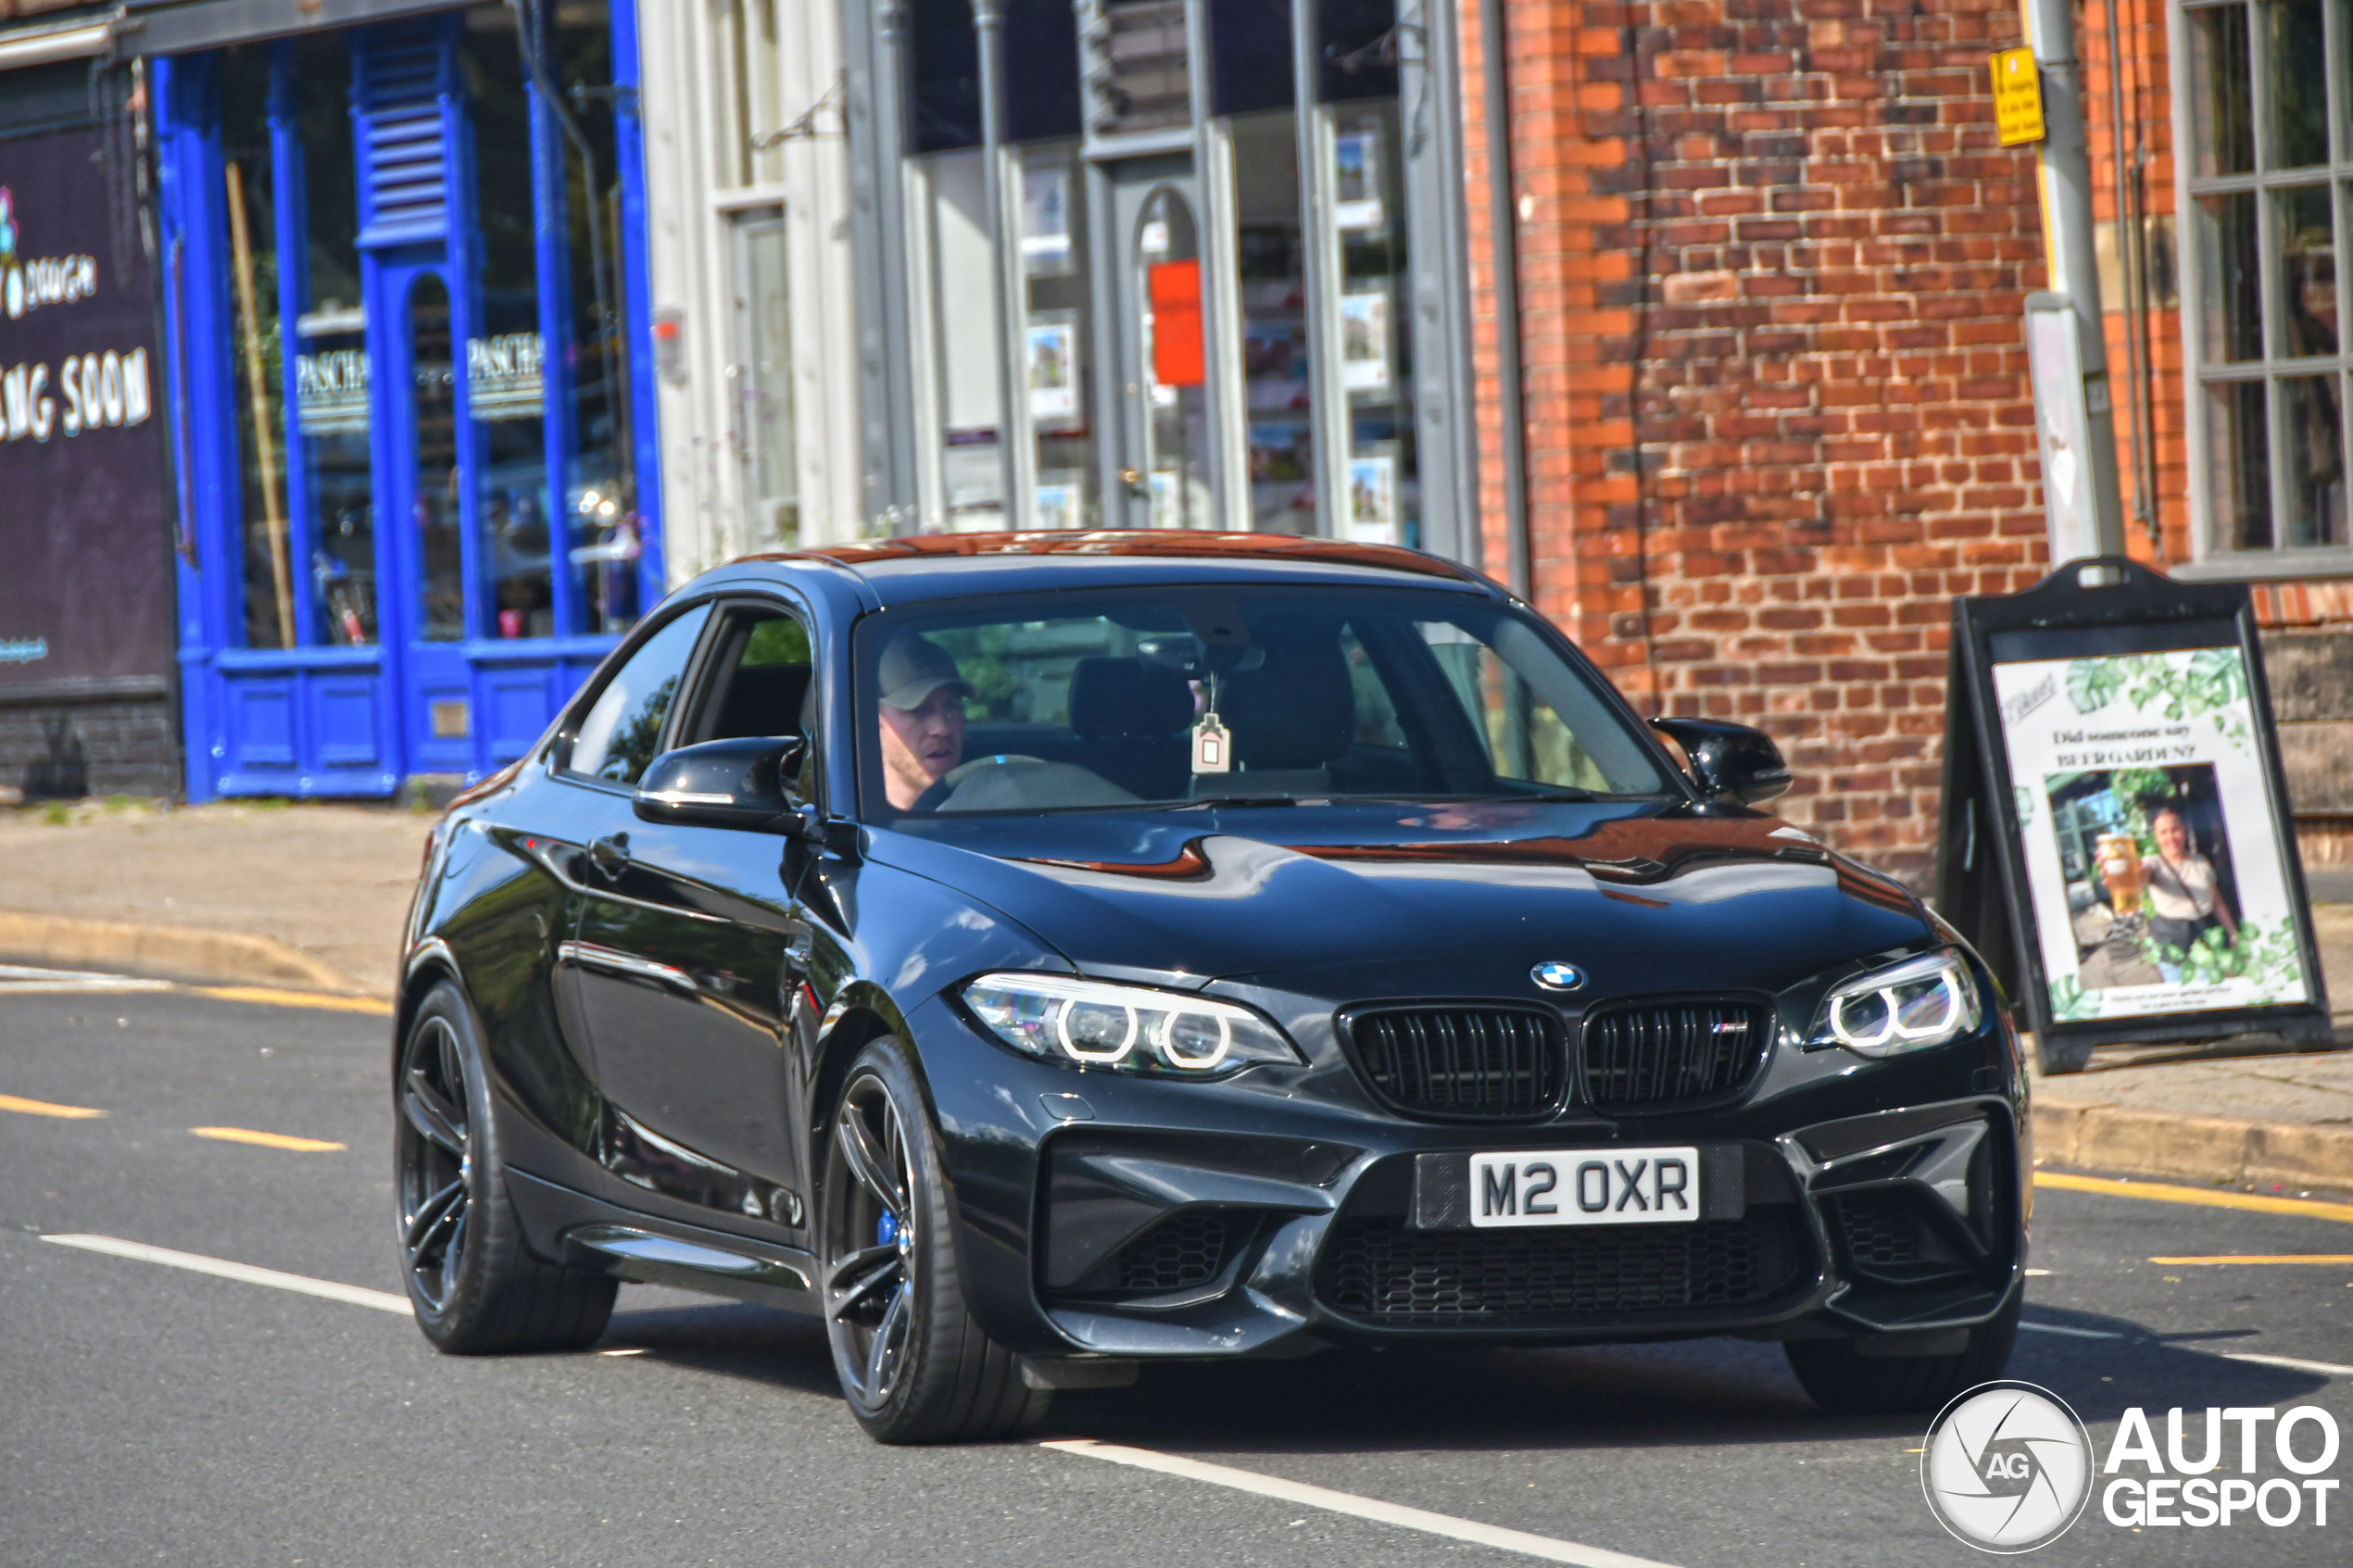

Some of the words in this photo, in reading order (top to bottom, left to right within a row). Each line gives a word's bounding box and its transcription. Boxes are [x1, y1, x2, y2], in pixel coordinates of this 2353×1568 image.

[0, 361, 56, 443] NG
[61, 346, 151, 437] SOON
[2053, 729, 2083, 745] Did
[1481, 1161, 1558, 1217] M2
[1576, 1158, 1688, 1213] OXR
